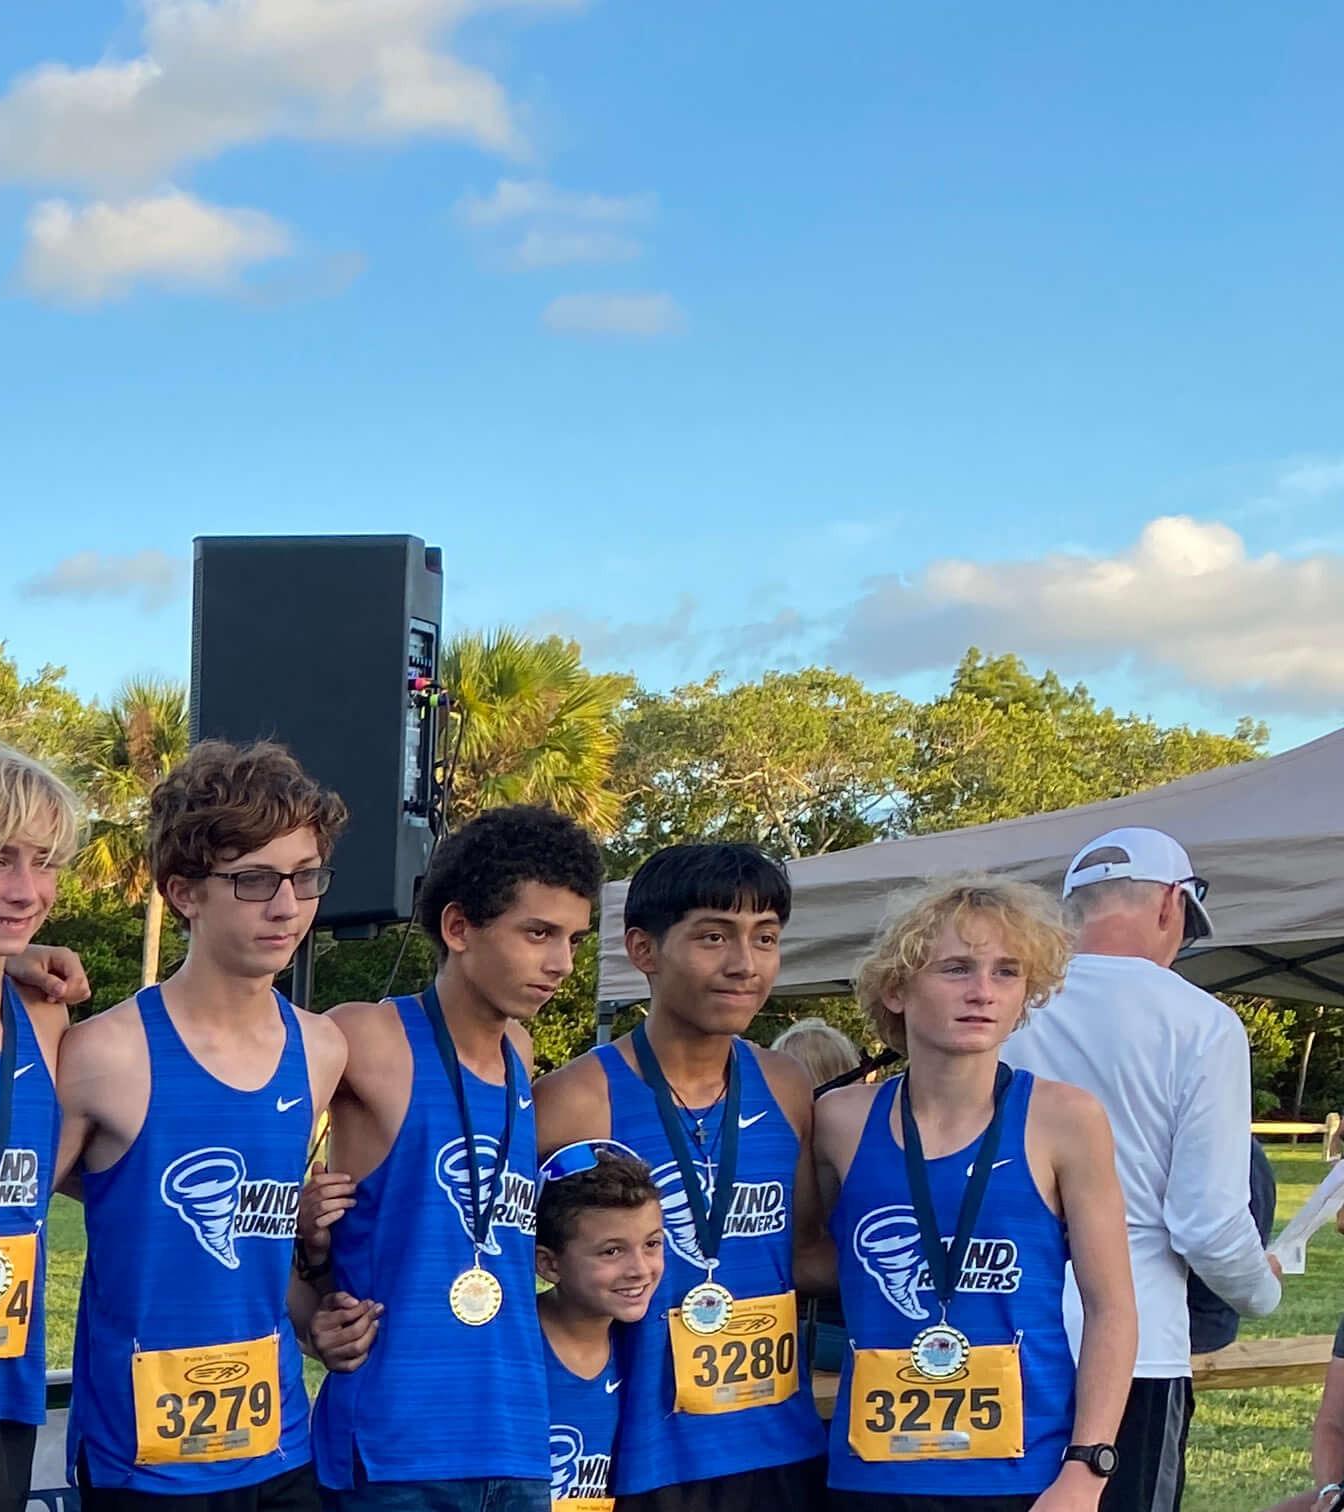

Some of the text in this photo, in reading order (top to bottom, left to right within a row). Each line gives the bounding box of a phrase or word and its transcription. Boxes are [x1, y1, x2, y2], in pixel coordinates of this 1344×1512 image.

[729, 1185, 782, 1215] IND
[233, 1214, 297, 1236] RUNNER
[693, 1332, 794, 1388] 3280
[156, 1381, 272, 1439] 3279
[865, 1387, 1003, 1433] 3275
